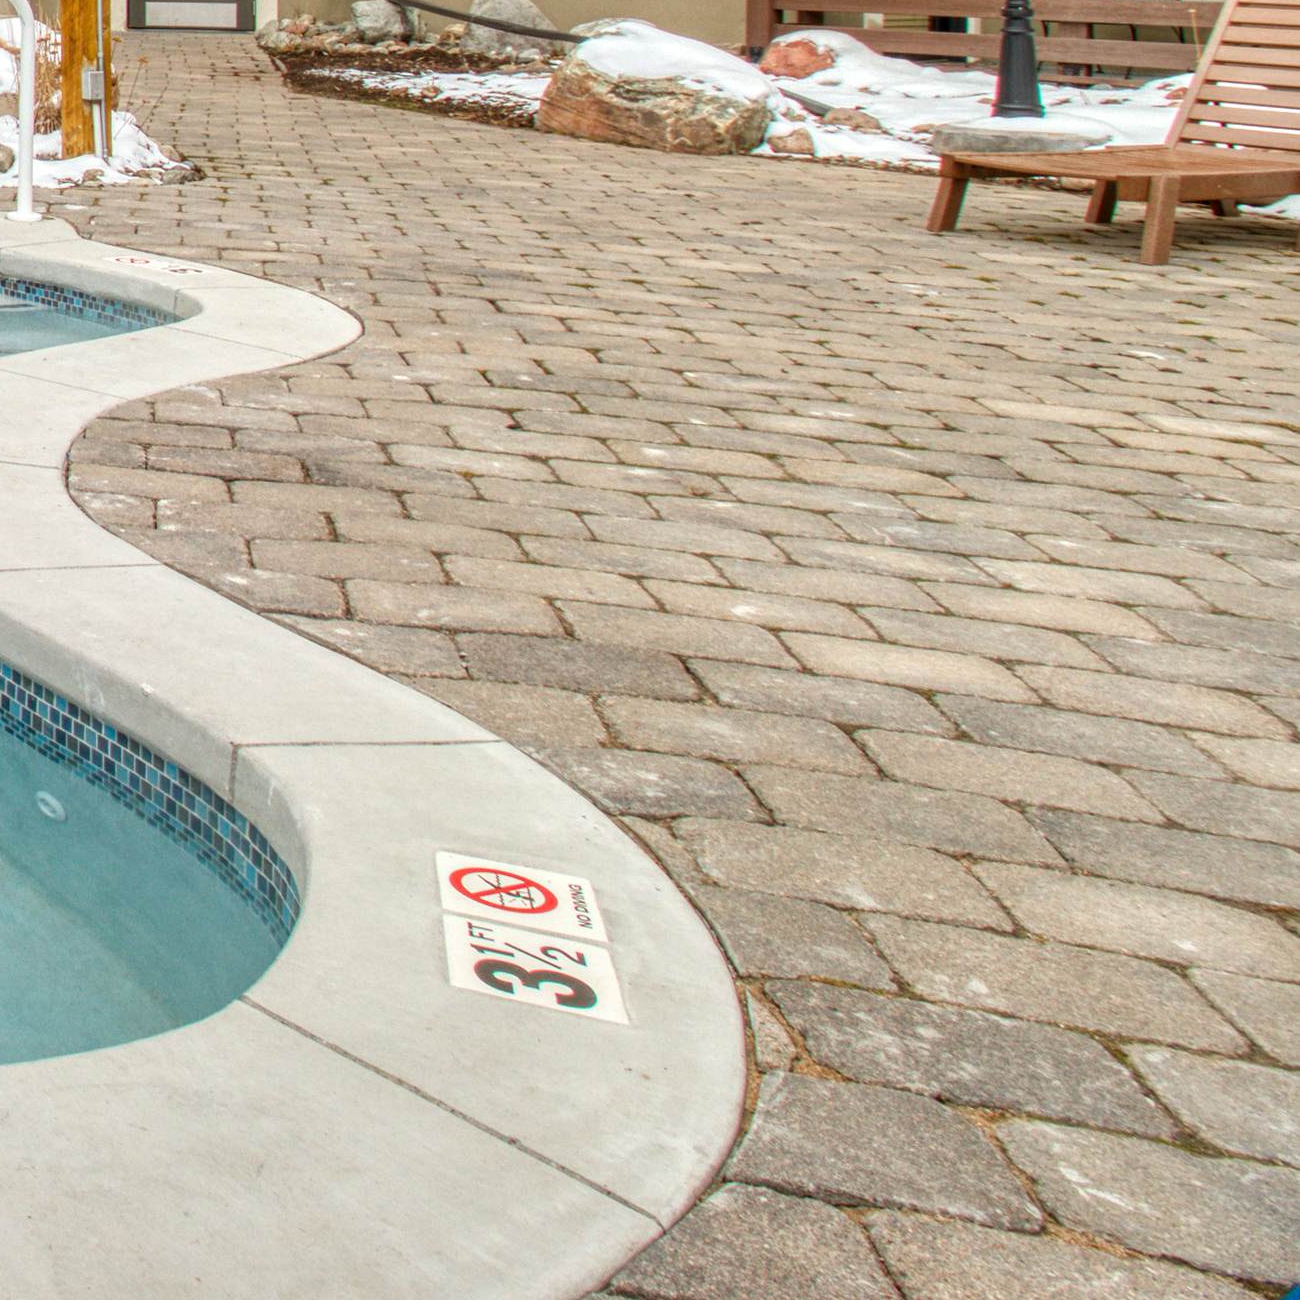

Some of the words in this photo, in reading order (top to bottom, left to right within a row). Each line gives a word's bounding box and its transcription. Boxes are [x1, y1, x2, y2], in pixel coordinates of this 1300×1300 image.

[569, 884, 589, 913] DIVING
[576, 914, 593, 929] NO
[467, 922, 495, 942] FT
